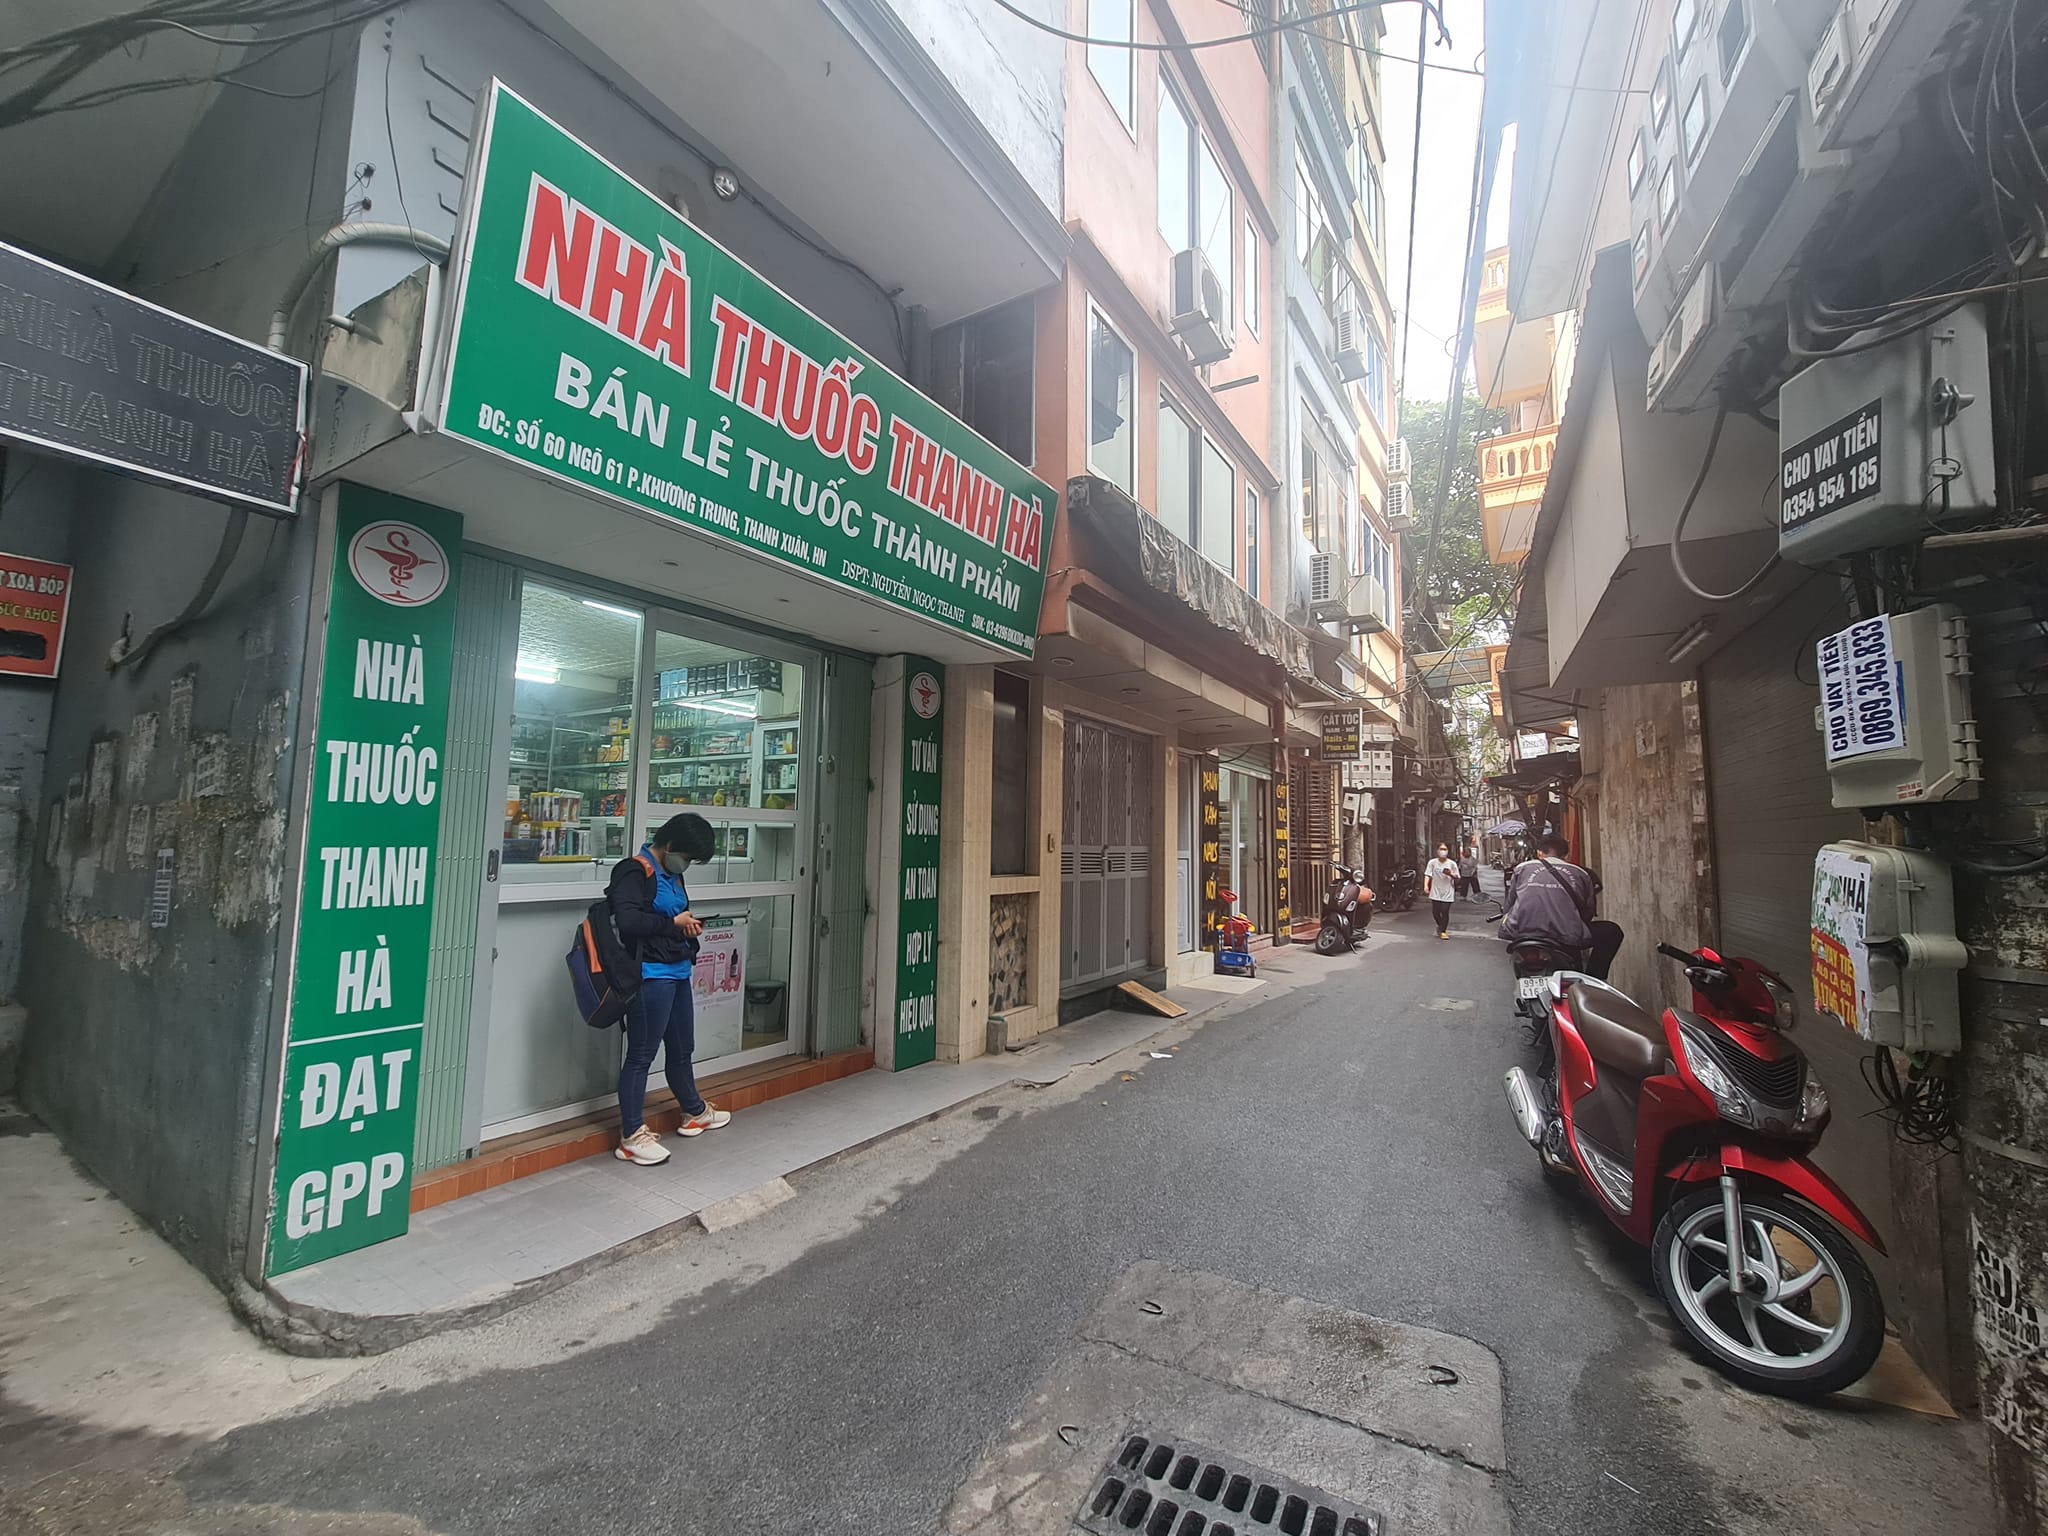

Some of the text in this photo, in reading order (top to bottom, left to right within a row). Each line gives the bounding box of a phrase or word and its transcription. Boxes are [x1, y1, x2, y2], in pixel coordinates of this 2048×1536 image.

[0, 283, 119, 374] NHÀ
[130, 332, 287, 427] THUỐC
[515, 171, 1044, 572] NHÀ THUỐC THANH HÀ
[0, 362, 194, 463] THANH
[208, 429, 273, 488] HÀ
[478, 402, 511, 438] ĐC:
[514, 418, 543, 450] SỐ
[543, 431, 565, 460] 60
[568, 441, 603, 475] NGÕ
[605, 457, 623, 484] 61
[699, 496, 740, 535] TRUNG,
[743, 516, 780, 548] THANH
[780, 531, 810, 563] XUÂN,
[812, 545, 828, 568] HN
[554, 352, 1021, 612] BÁN LẺ THUỐC THÀNH PHẨM
[1783, 452, 1811, 489] CHO
[1814, 435, 1840, 474] VAY
[1783, 455, 1878, 524] 0354 954 185
[7, 571, 35, 591] XOA
[38, 574, 65, 595] BÓP
[841, 559, 869, 587] DSPT:
[912, 589, 938, 613] NGỌC
[937, 601, 966, 624] THANH
[353, 634, 425, 705] NHÀ
[1826, 681, 1843, 713] VAY
[1851, 620, 1896, 746] 0869.345.833
[1342, 711, 1359, 725] TÓC
[1830, 715, 1849, 753] CHO
[326, 725, 438, 805] THUỐC
[911, 731, 938, 773] TƯ VẤN
[906, 789, 939, 843] SỬ DỤNG
[320, 847, 428, 910] THANH
[904, 861, 937, 900] AN TOÀN
[335, 935, 392, 1015] HÀ
[906, 923, 933, 973] HỢP LÝ
[900, 980, 934, 1040] HIỆU QUẢ
[299, 1049, 412, 1132] ĐẠT
[286, 1152, 405, 1239] GPP
